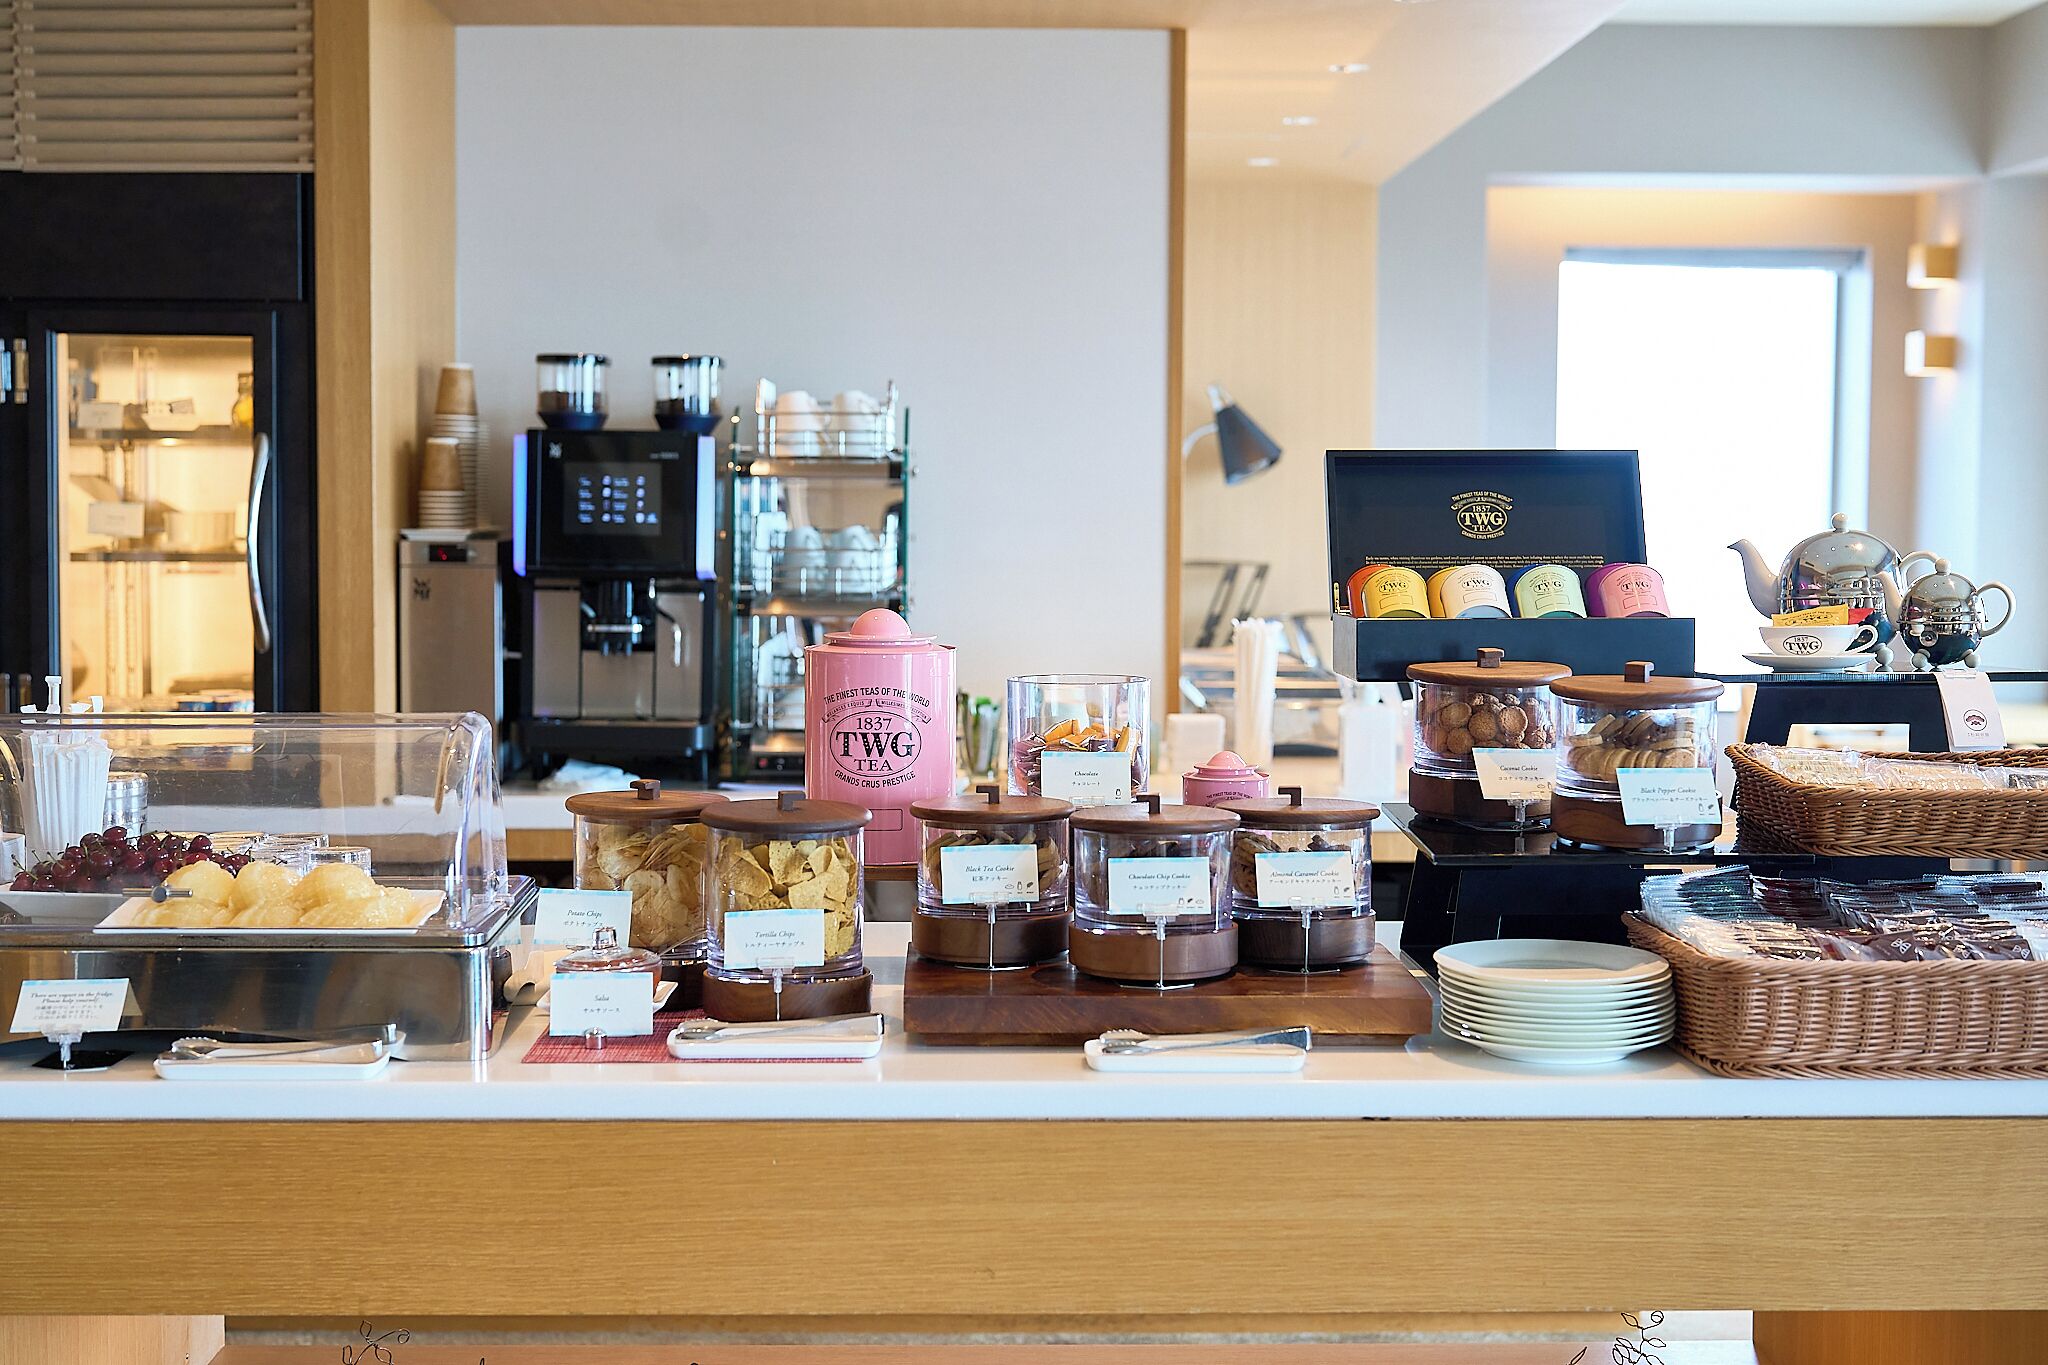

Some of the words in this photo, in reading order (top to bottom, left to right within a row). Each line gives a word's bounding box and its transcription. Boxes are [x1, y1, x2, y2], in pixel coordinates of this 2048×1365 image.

[1461, 512, 1504, 525] TWG
[1786, 641, 1819, 651] TWG
[824, 695, 836, 704] THE
[835, 688, 858, 700] FINEST
[860, 687, 879, 696] TEAS
[882, 688, 891, 696] OF
[893, 688, 906, 699] THE
[909, 693, 930, 708] WORLD
[857, 717, 892, 730] 1837
[836, 731, 915, 757] TWG
[854, 759, 893, 771] TEA
[835, 769, 860, 787] GRANDS
[862, 780, 880, 788] CRUS
[883, 770, 916, 787] PRESTIGE
[587, 910, 602, 918] Chips
[778, 930, 796, 938] Chips
